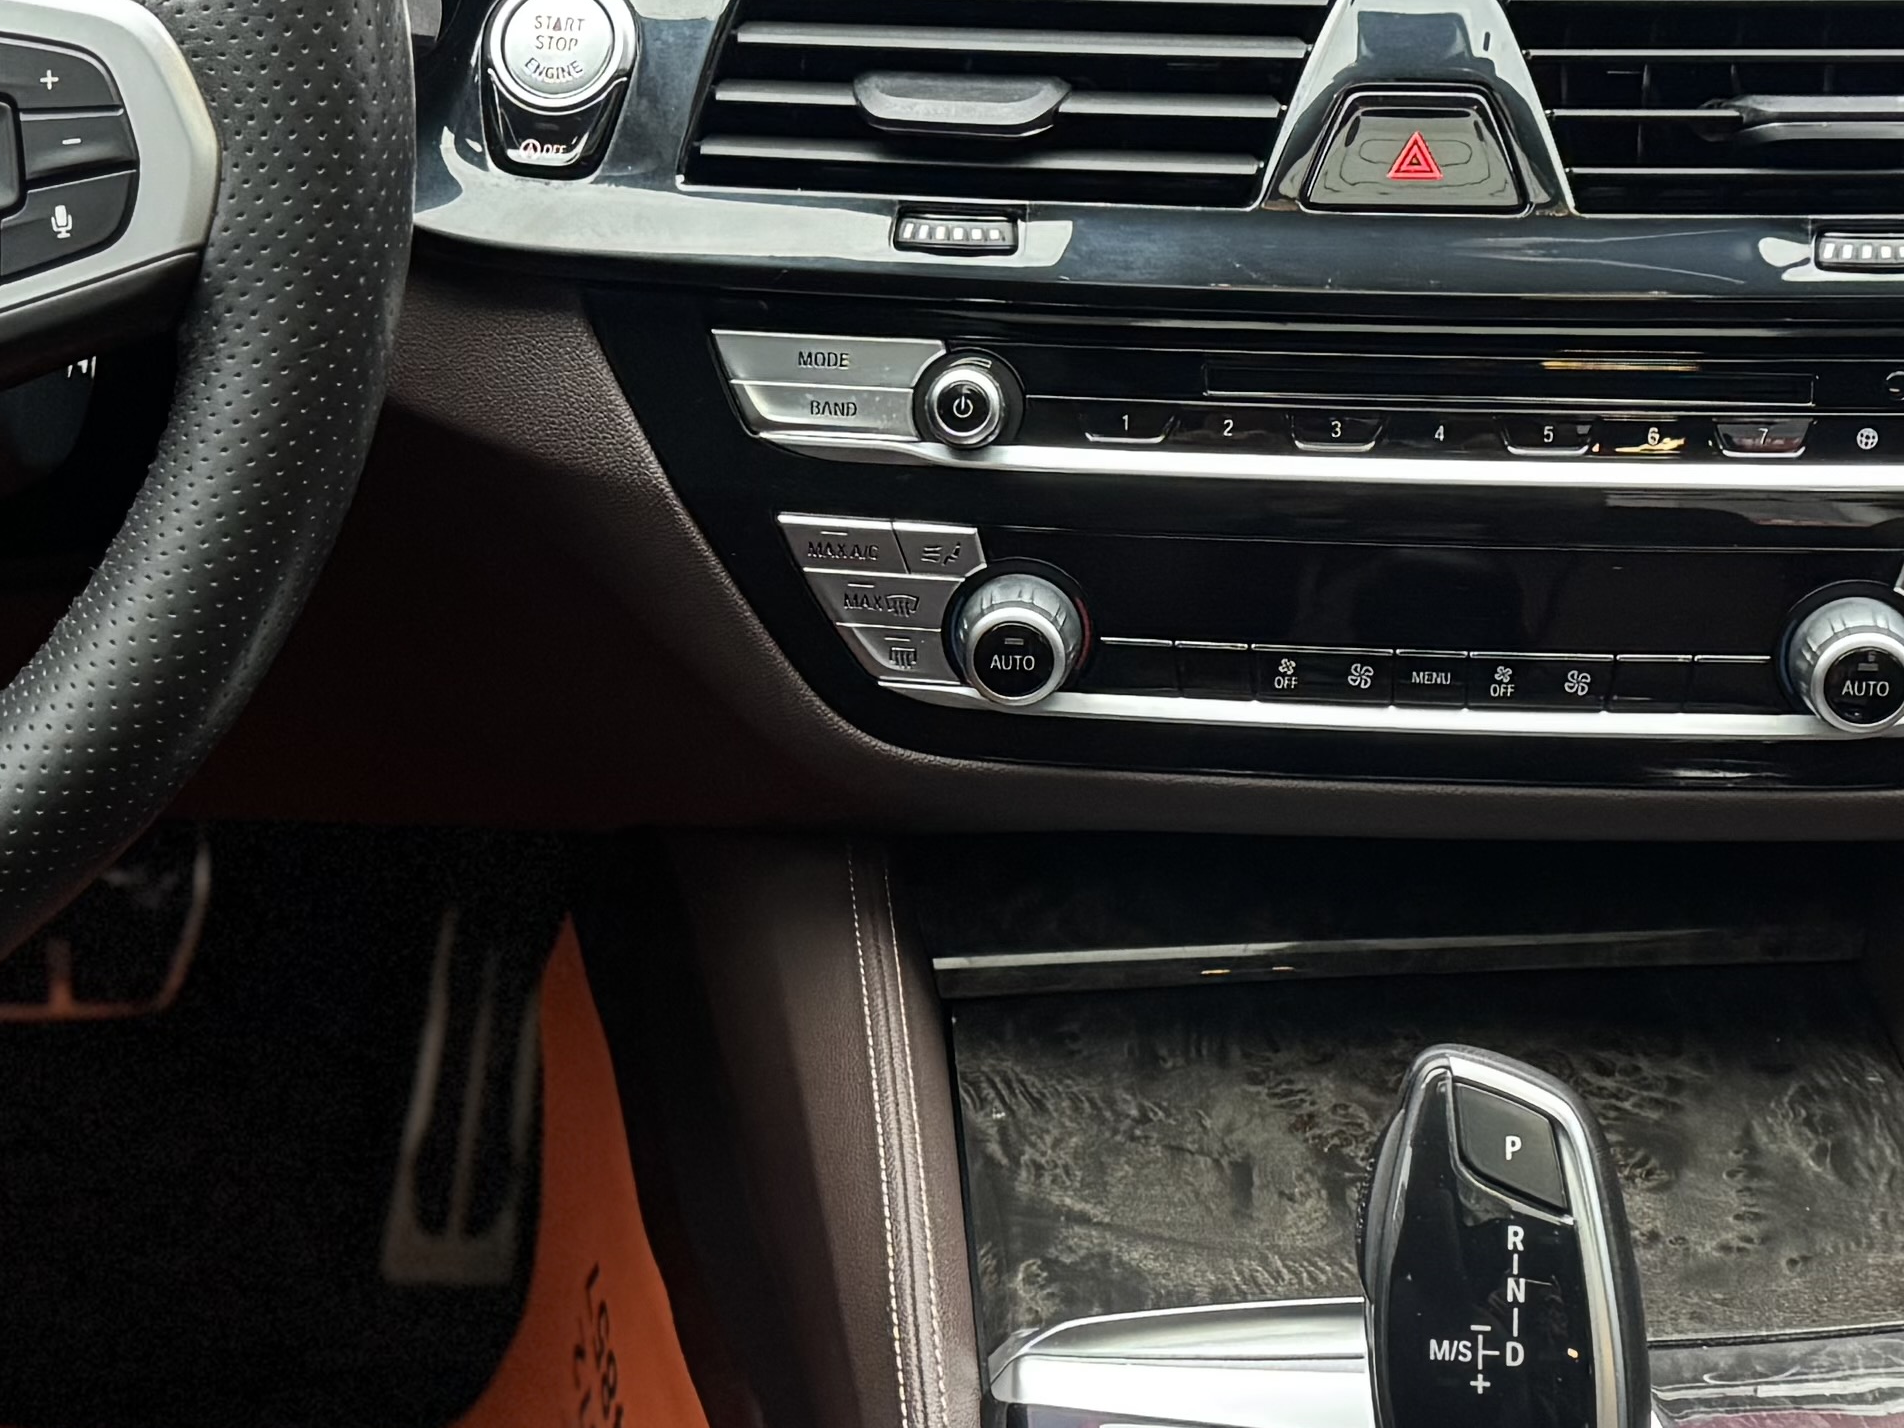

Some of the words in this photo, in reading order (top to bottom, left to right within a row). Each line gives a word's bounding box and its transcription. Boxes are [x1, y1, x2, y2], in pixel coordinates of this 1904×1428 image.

[534, 14, 586, 33] START
[535, 34, 579, 52] STOP
[524, 56, 584, 81] ENGINE
[798, 350, 850, 369] MODE
[810, 400, 858, 417] BAND
[1122, 414, 1129, 431] 1
[1222, 419, 1235, 437] 2
[1330, 420, 1342, 438] 3
[1434, 424, 1445, 442] 4
[1543, 425, 1555, 443] 5
[1647, 426, 1661, 446] 6
[1757, 427, 1770, 446] 7
[807, 541, 846, 559] MAX
[843, 593, 883, 612] MAX
[990, 654, 1035, 671] AUTO
[1274, 675, 1299, 690] OFF
[1411, 671, 1452, 686] MENU
[1490, 683, 1515, 698] OFF
[1841, 680, 1890, 697] AUTO
[1505, 1135, 1522, 1161] P
[1507, 1225, 1525, 1252] R
[1506, 1278, 1526, 1304] N
[1429, 1338, 1473, 1363] M/S
[1505, 1341, 1525, 1367] D
